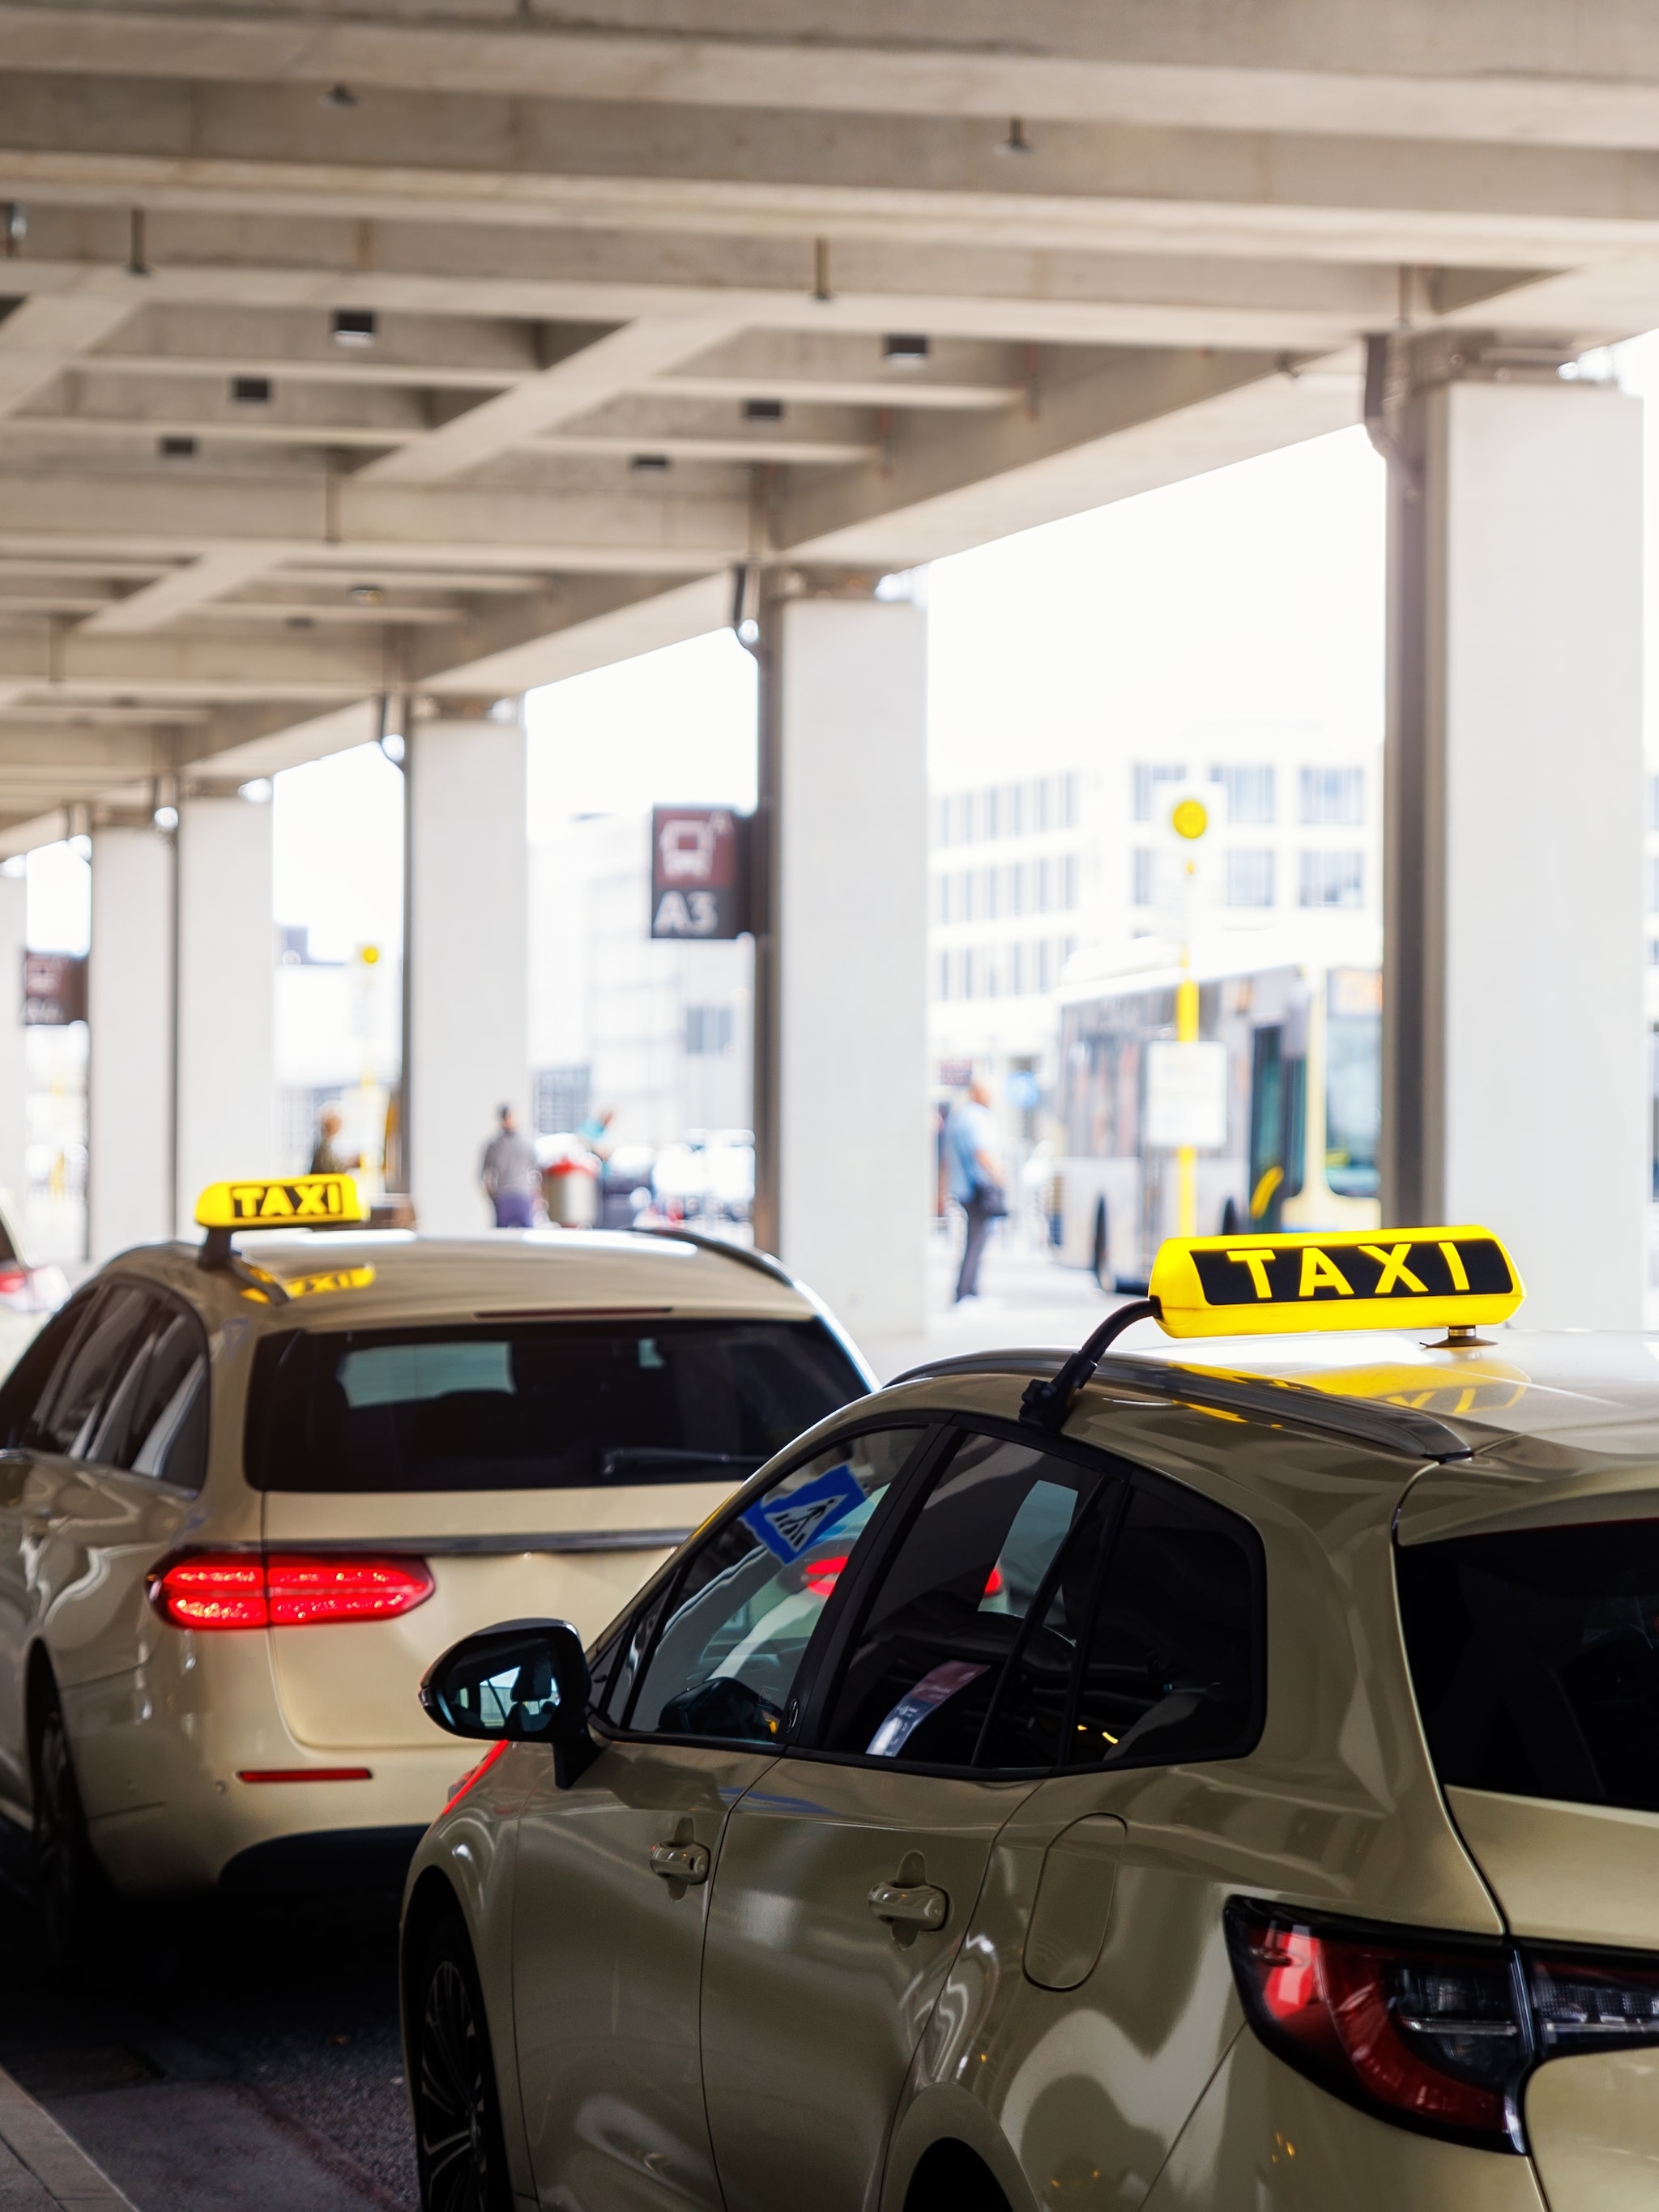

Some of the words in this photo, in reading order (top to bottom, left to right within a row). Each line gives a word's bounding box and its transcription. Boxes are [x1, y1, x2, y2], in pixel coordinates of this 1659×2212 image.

[653, 890, 718, 935] A3
[232, 1183, 342, 1217] TAXI
[1226, 1242, 1470, 1298] TAXI
